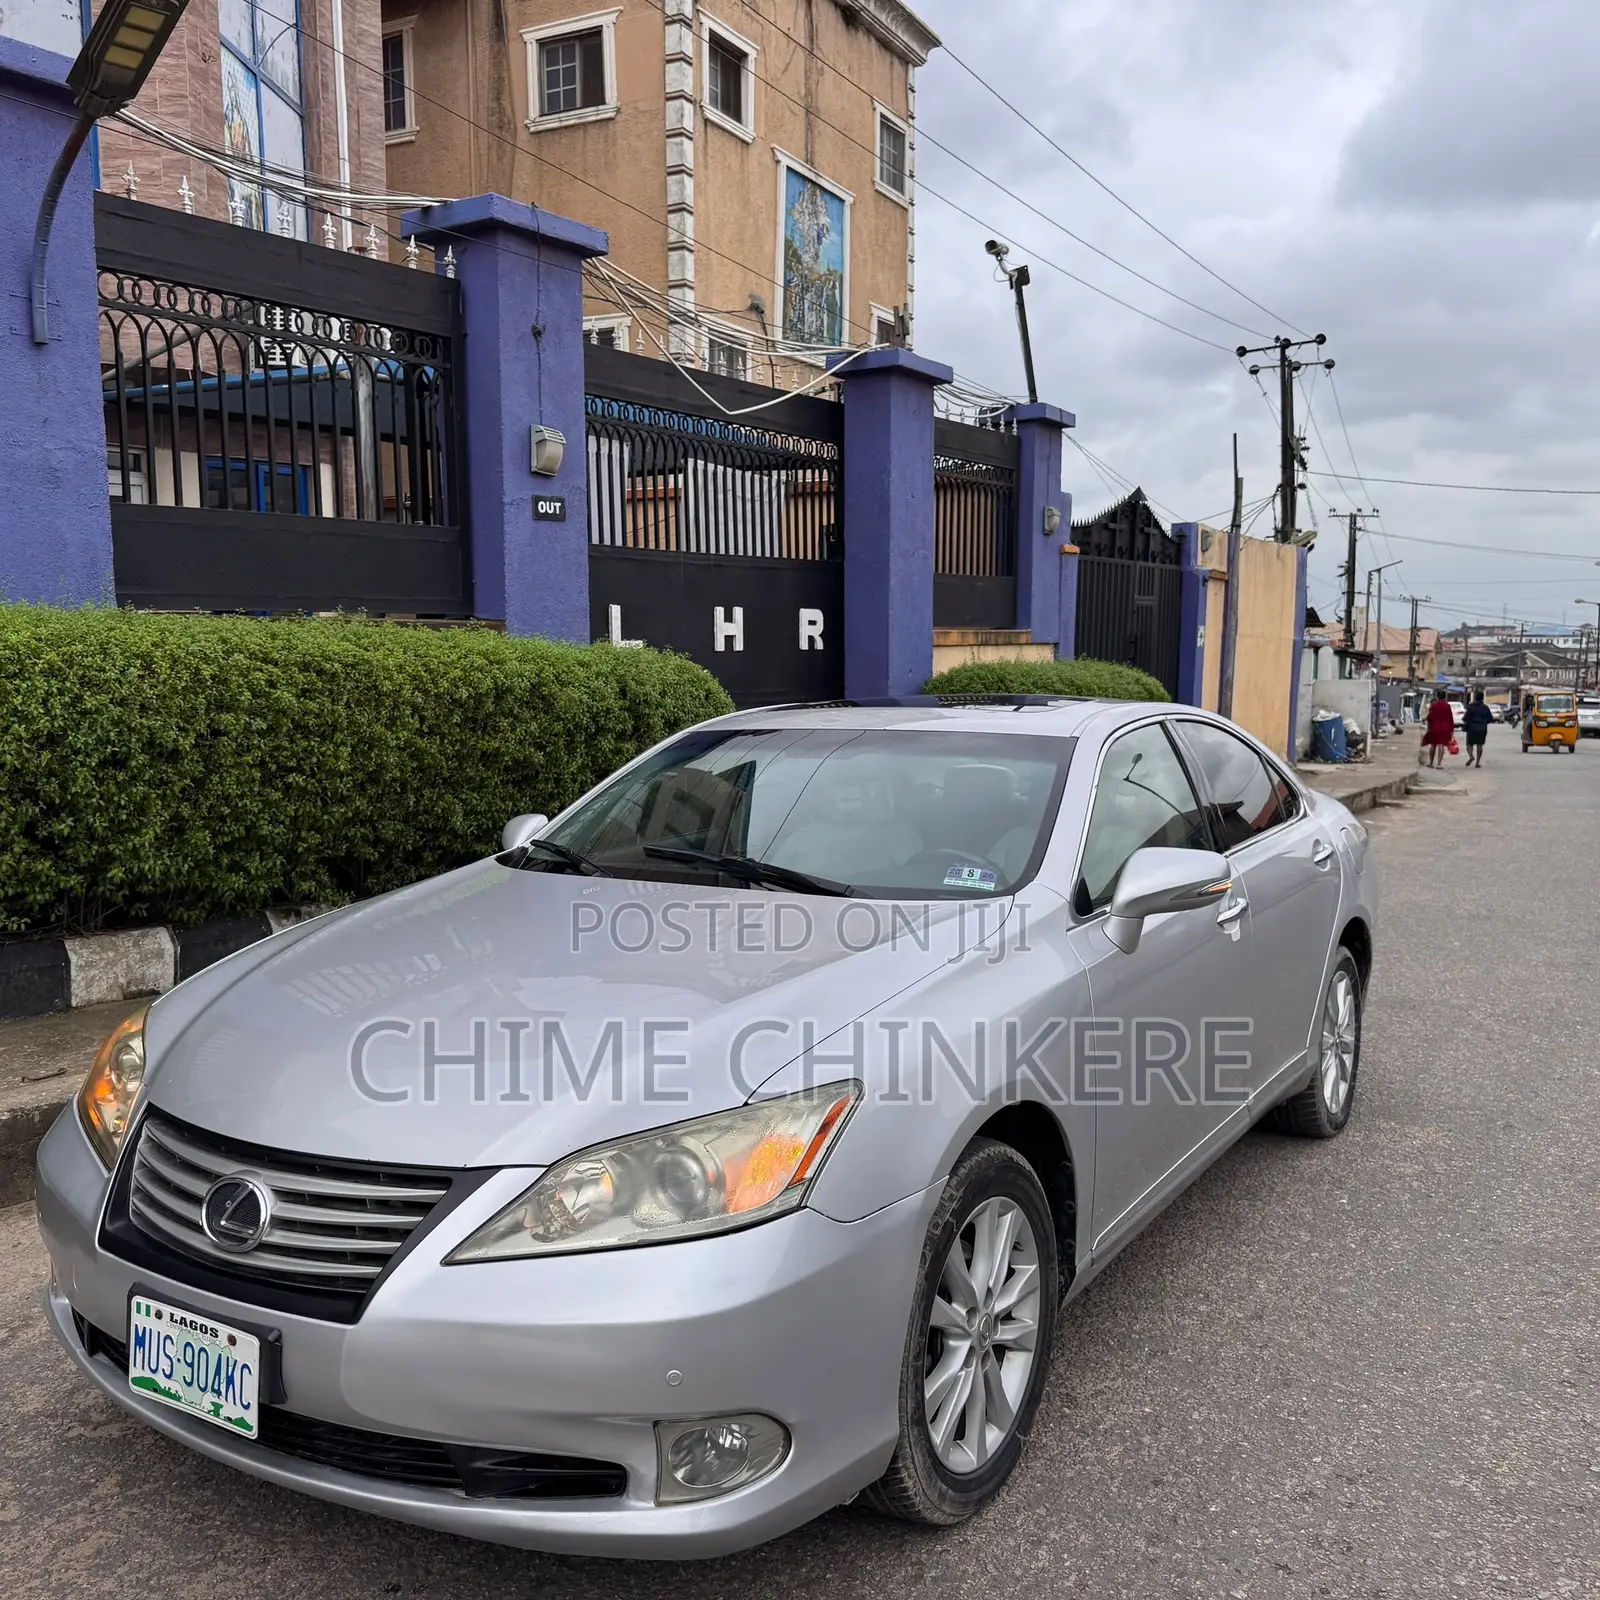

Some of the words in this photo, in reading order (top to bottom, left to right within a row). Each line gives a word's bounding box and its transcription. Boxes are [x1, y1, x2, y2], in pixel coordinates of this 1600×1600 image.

[537, 500, 562, 515] OUT
[713, 606, 744, 651] H
[799, 608, 824, 650] R
[967, 868, 975, 878] 8
[169, 1311, 219, 1339] LAGOS
